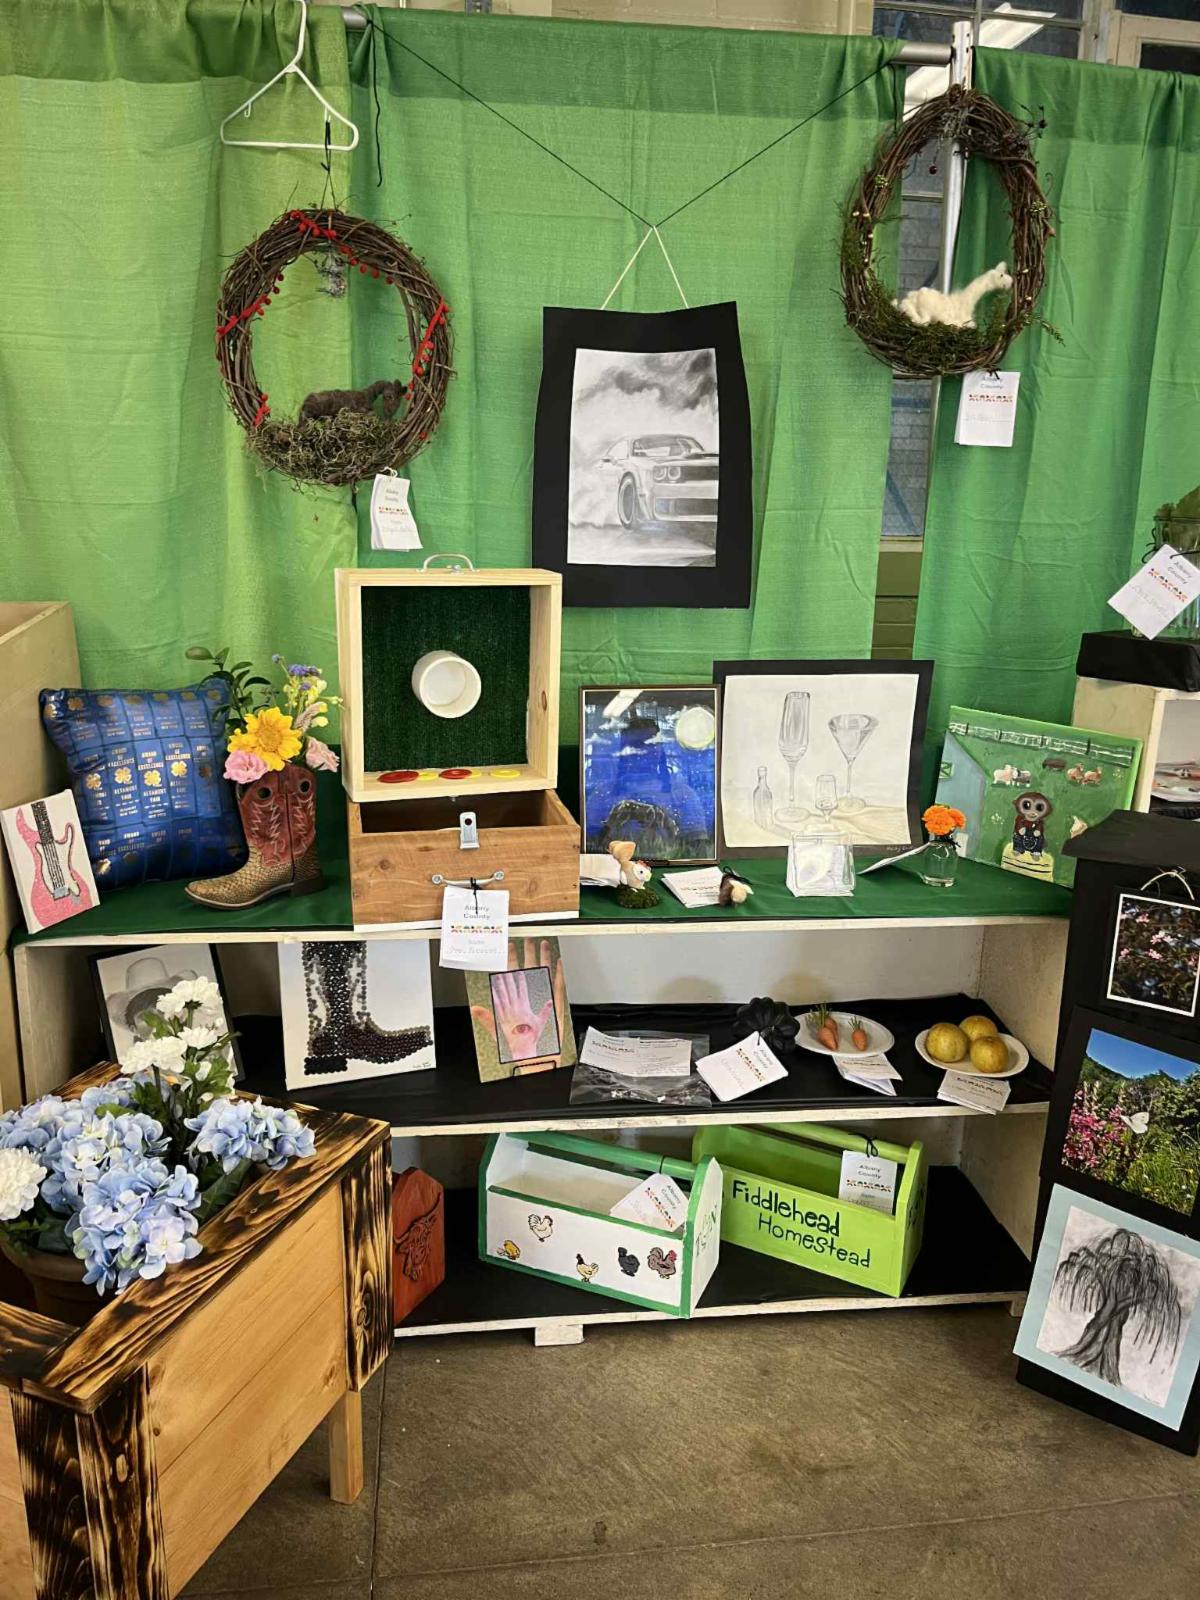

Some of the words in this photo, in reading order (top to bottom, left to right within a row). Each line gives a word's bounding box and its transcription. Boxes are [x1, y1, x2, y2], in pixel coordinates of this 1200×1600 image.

[857, 1171, 882, 1180] County
[858, 1164, 882, 1173] Albany
[732, 1180, 840, 1237] Fiddlehead
[758, 1212, 870, 1268] Homestead
